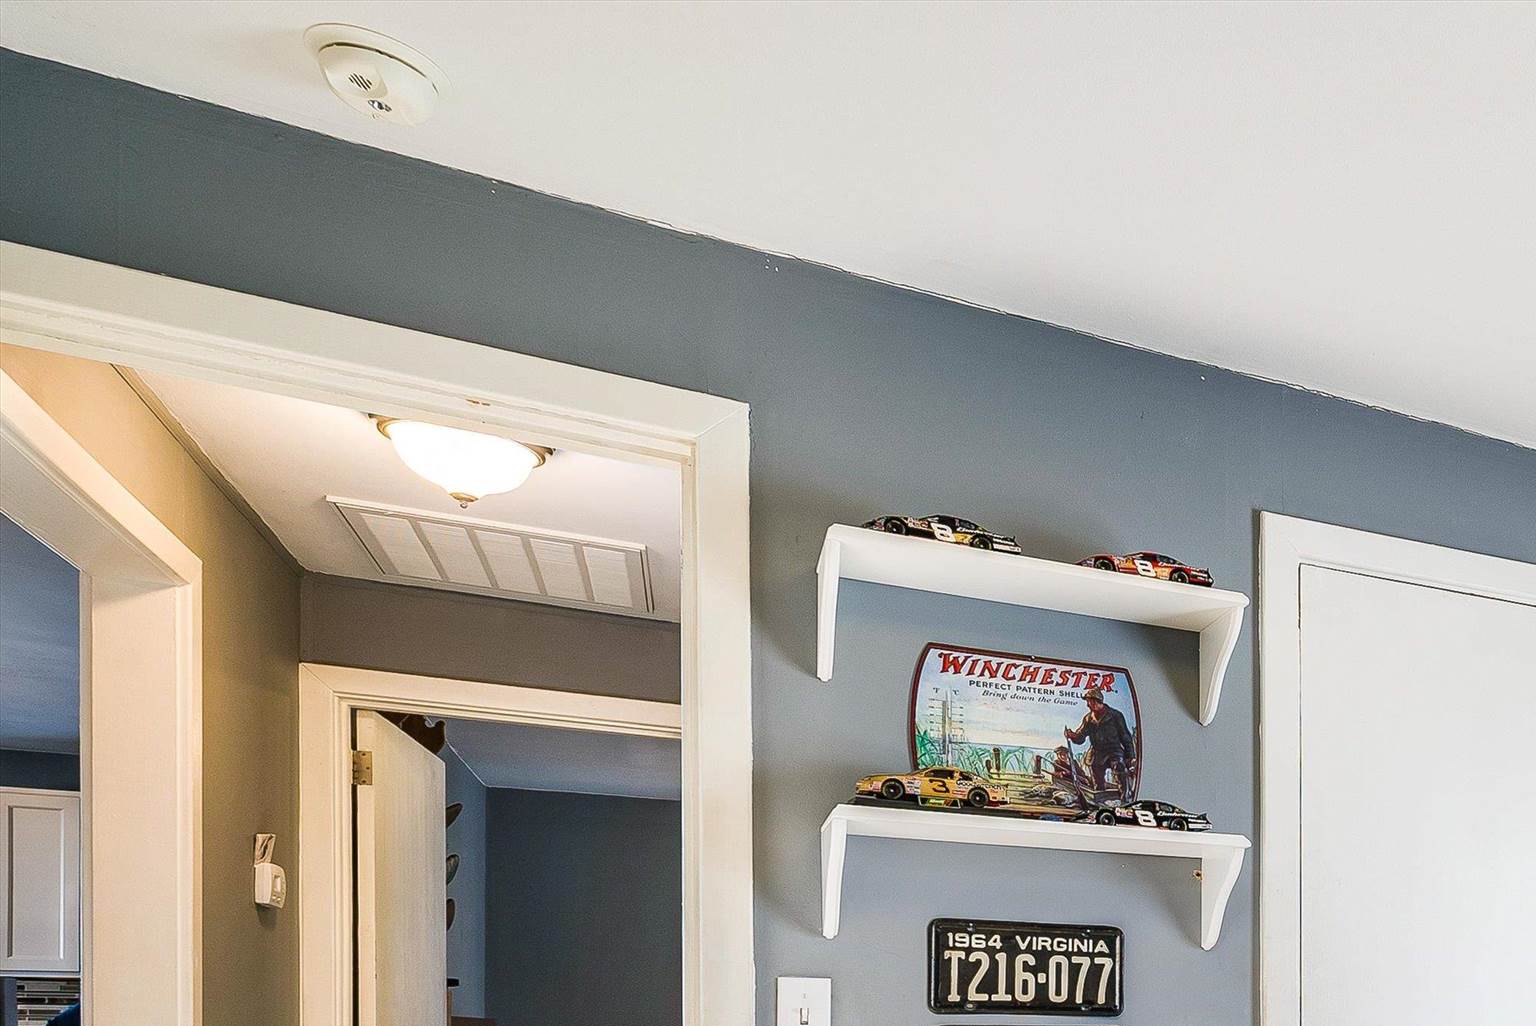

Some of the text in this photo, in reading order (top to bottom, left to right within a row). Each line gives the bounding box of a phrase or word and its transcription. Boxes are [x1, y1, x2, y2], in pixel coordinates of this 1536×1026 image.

[930, 522, 956, 543] 8
[1134, 560, 1157, 577] 8
[969, 680, 1011, 691] PERFECT
[1016, 685, 1055, 696] PATTERN
[982, 690, 1008, 701] Bring
[1010, 693, 1035, 702] down
[1054, 698, 1078, 706] Game
[929, 779, 949, 793] 3
[1134, 810, 1157, 827] 8
[947, 932, 1110, 953] 1964 VIRGINIA
